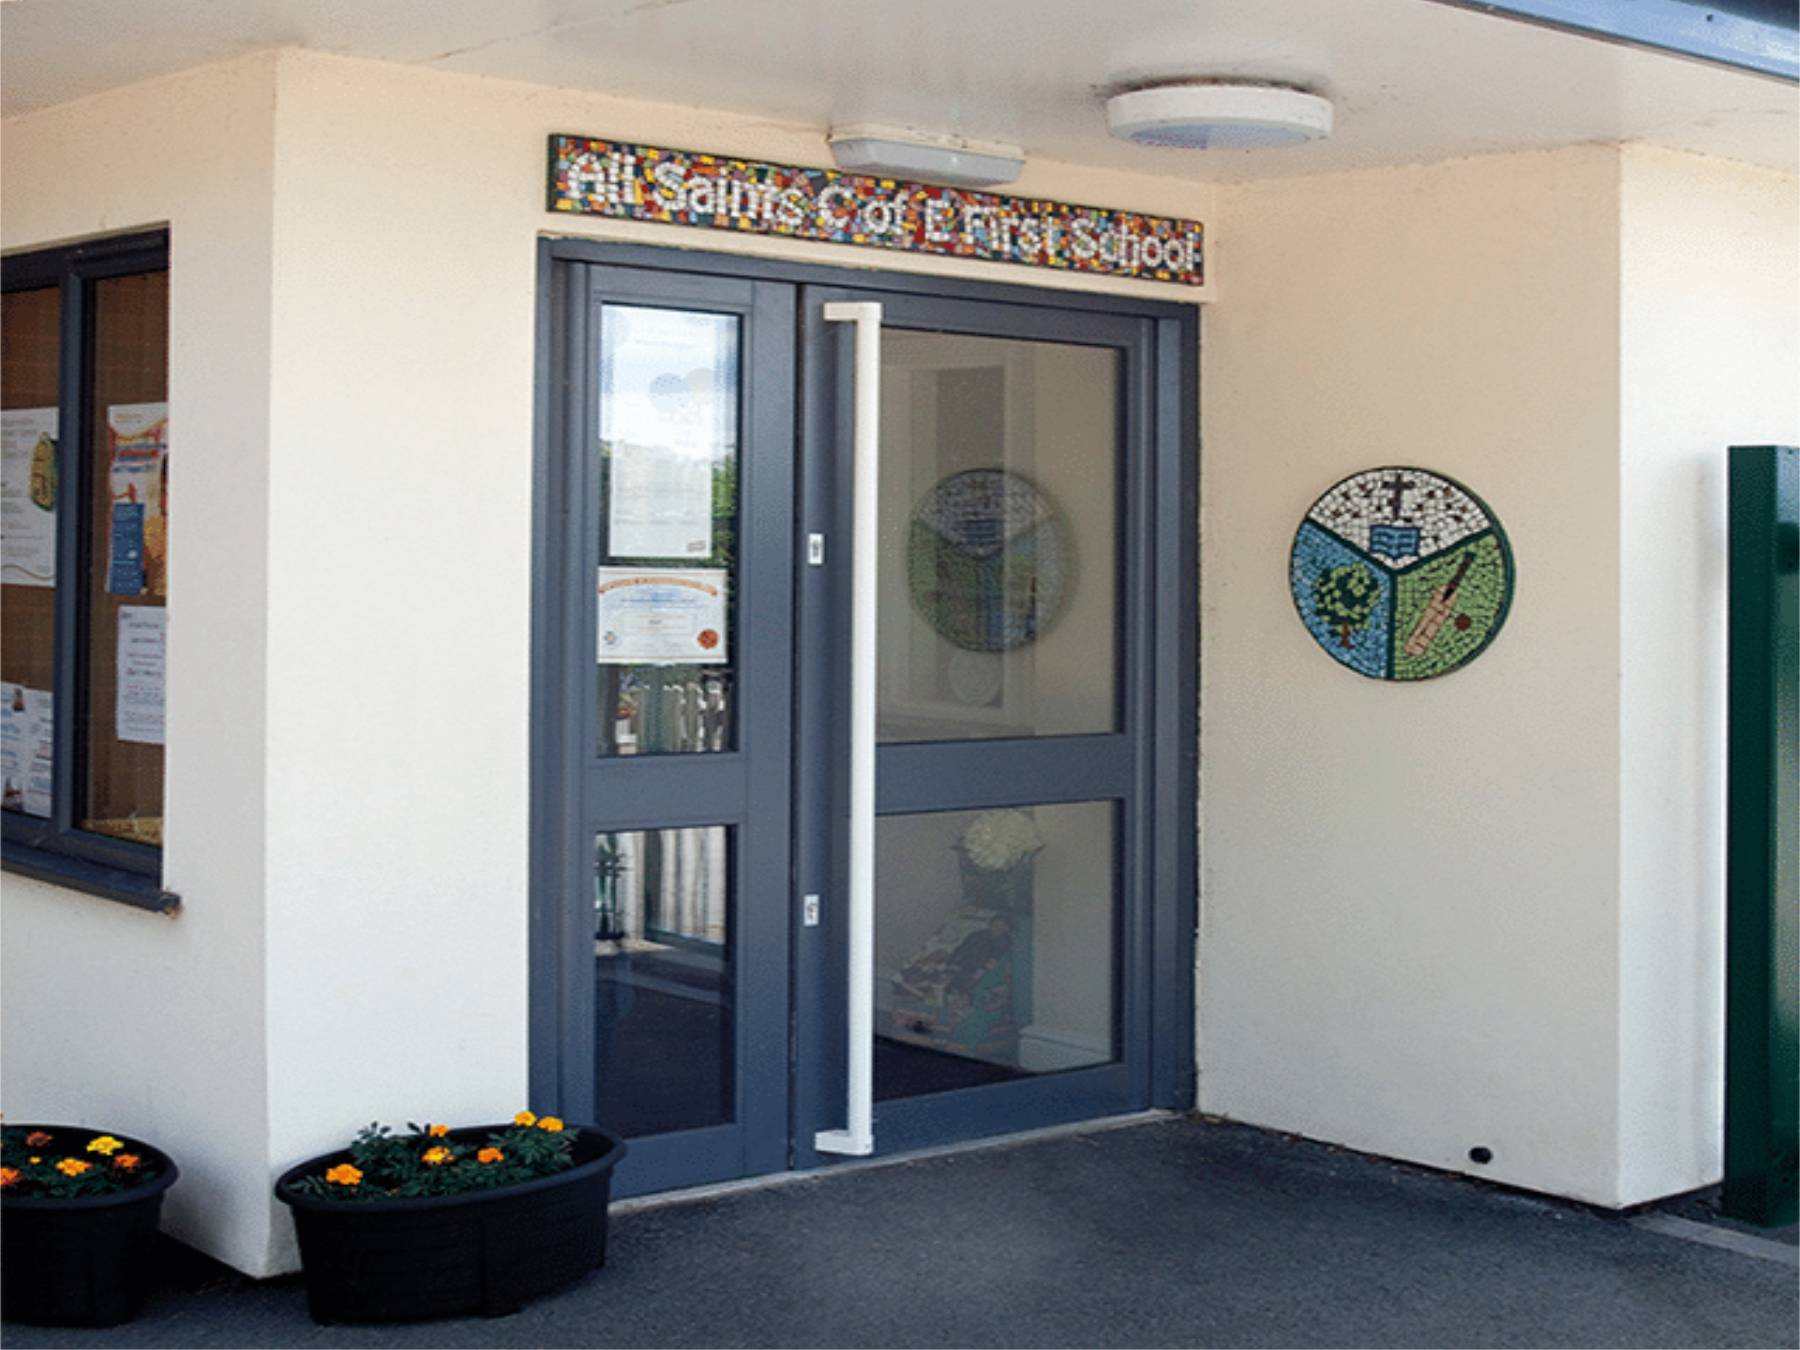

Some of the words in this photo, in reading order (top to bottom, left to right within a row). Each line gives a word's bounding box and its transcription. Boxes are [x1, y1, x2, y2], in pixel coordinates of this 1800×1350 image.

[567, 152, 636, 204] All
[652, 160, 804, 225] Saints
[818, 185, 853, 229] C
[865, 190, 908, 236] of
[924, 197, 950, 241] E
[963, 205, 1056, 255] First
[1071, 218, 1196, 271] School
